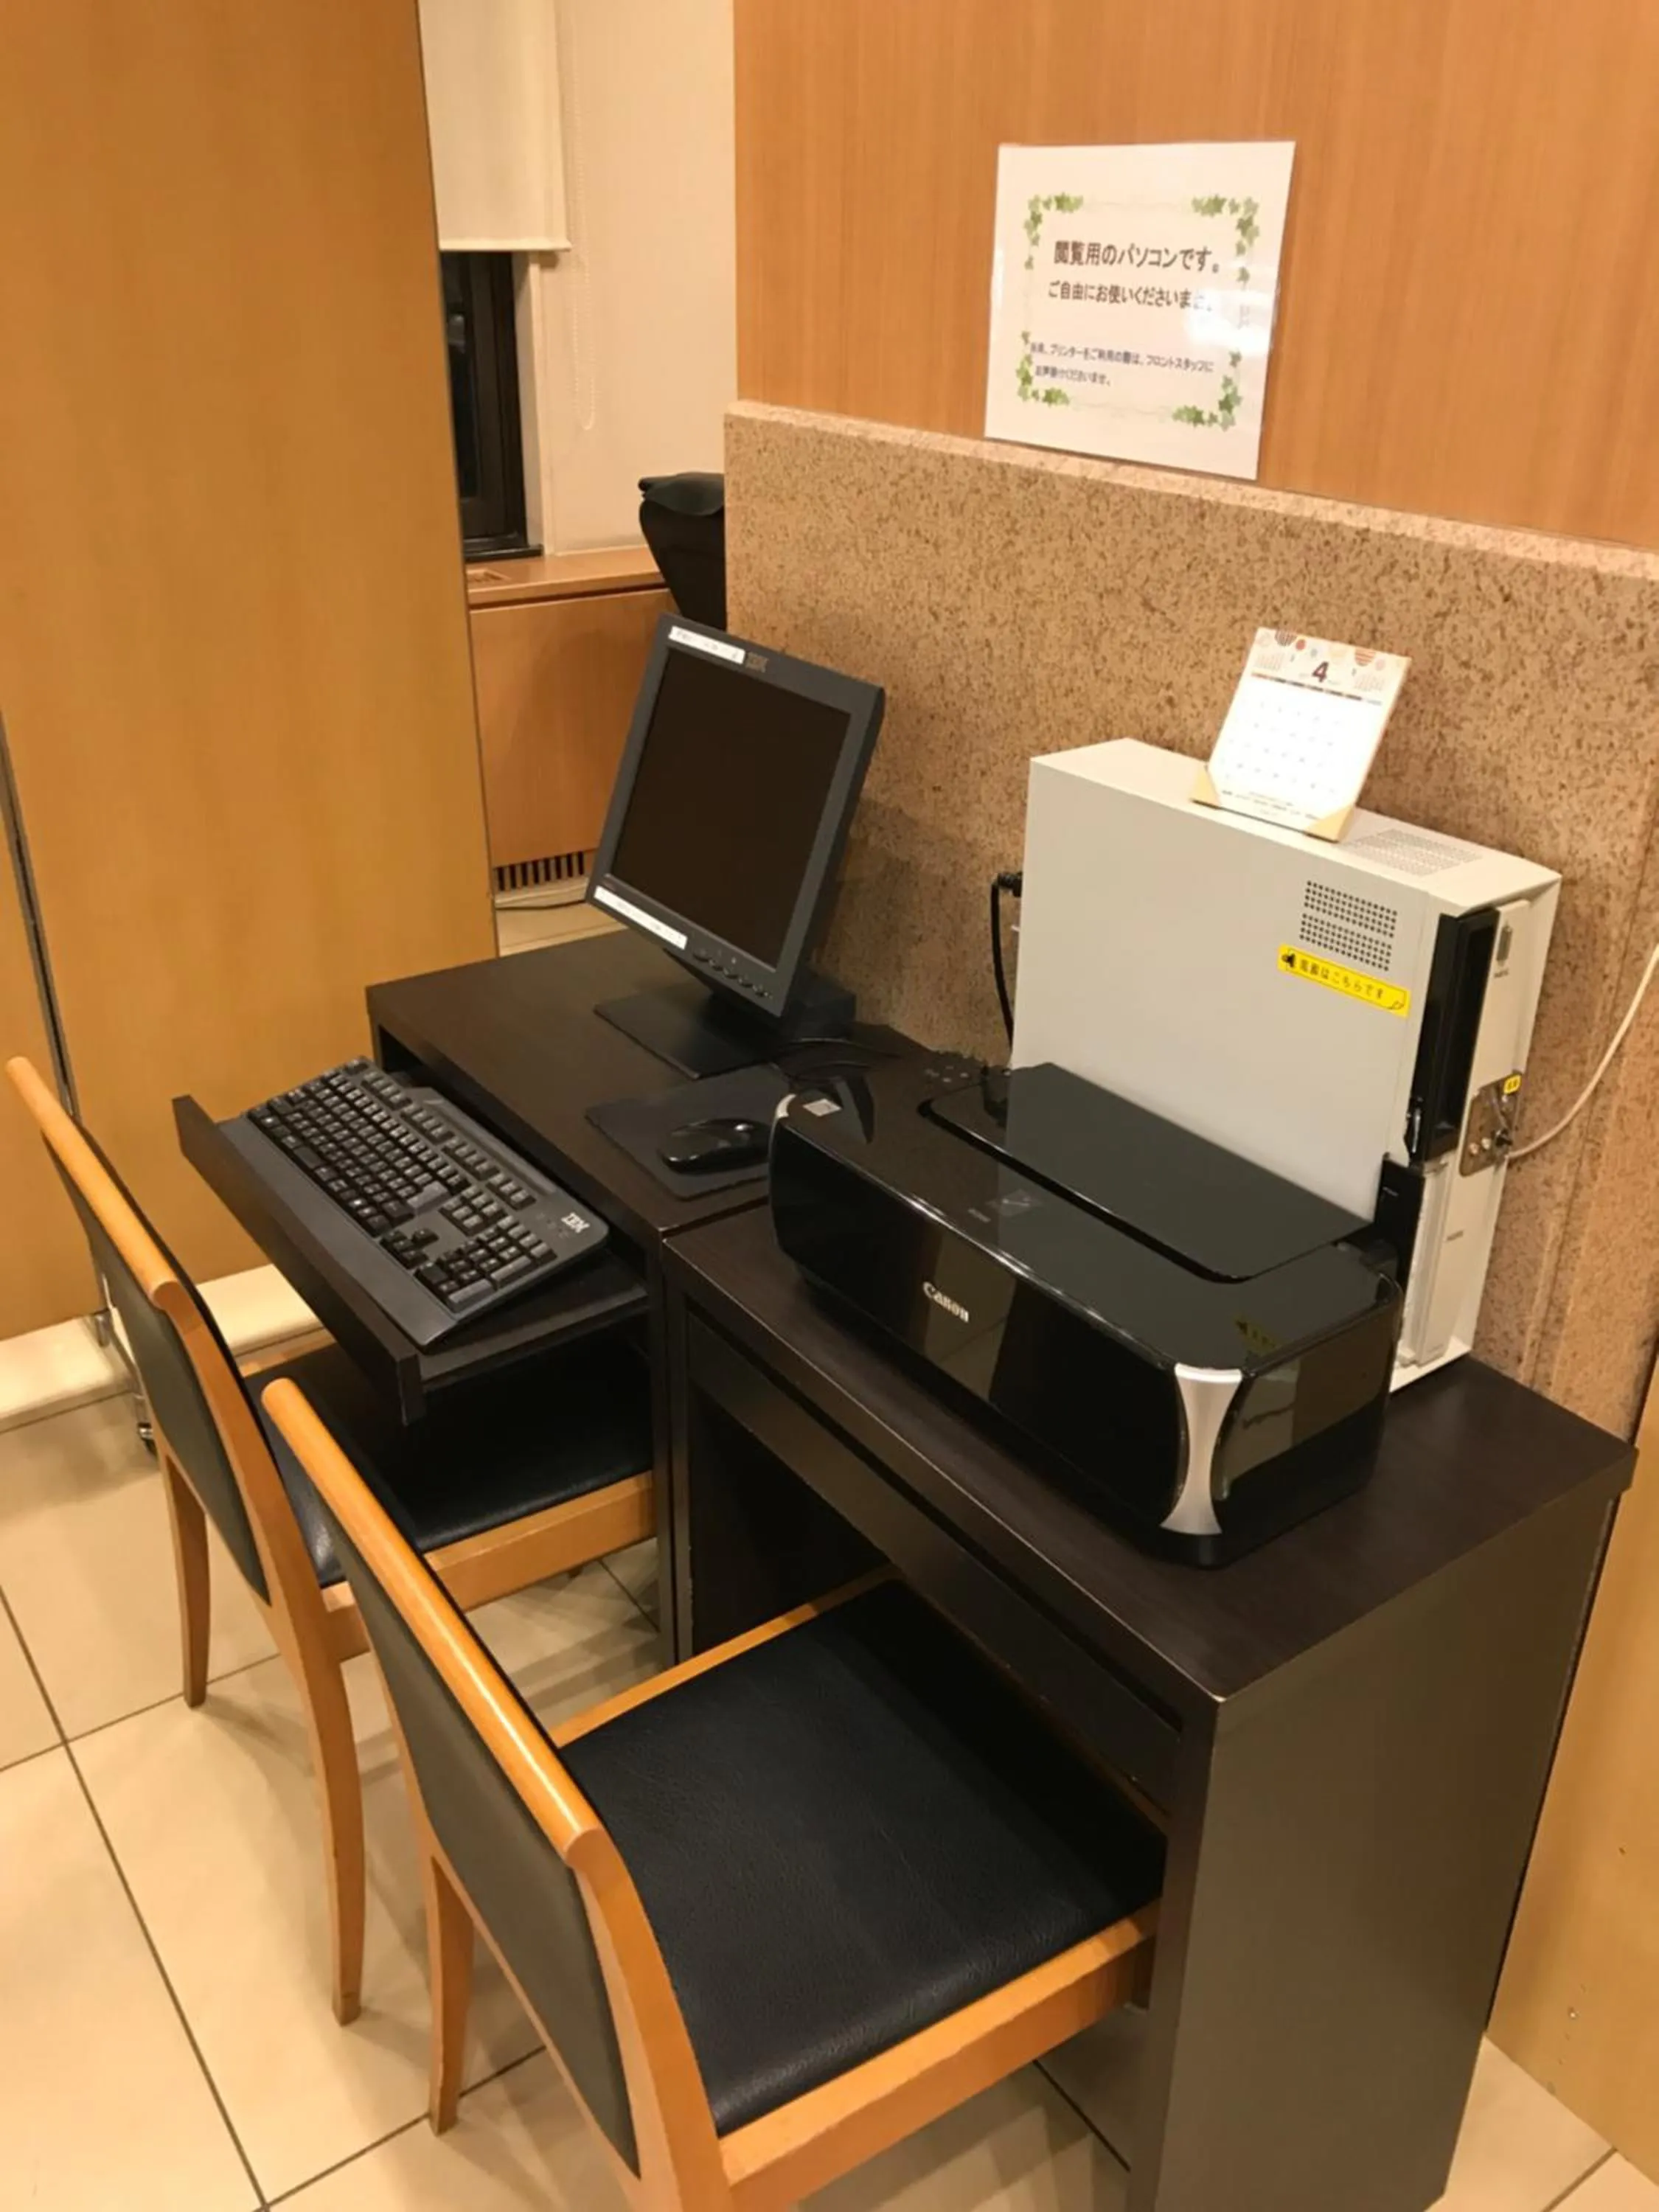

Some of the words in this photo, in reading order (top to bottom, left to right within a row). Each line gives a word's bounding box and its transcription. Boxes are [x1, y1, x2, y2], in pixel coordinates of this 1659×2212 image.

[1054, 240, 1220, 274] 閲覧用のパソコンです。
[1312, 661, 1329, 684] 4
[561, 1211, 591, 1234] IBM
[922, 1281, 970, 1324] Canon
